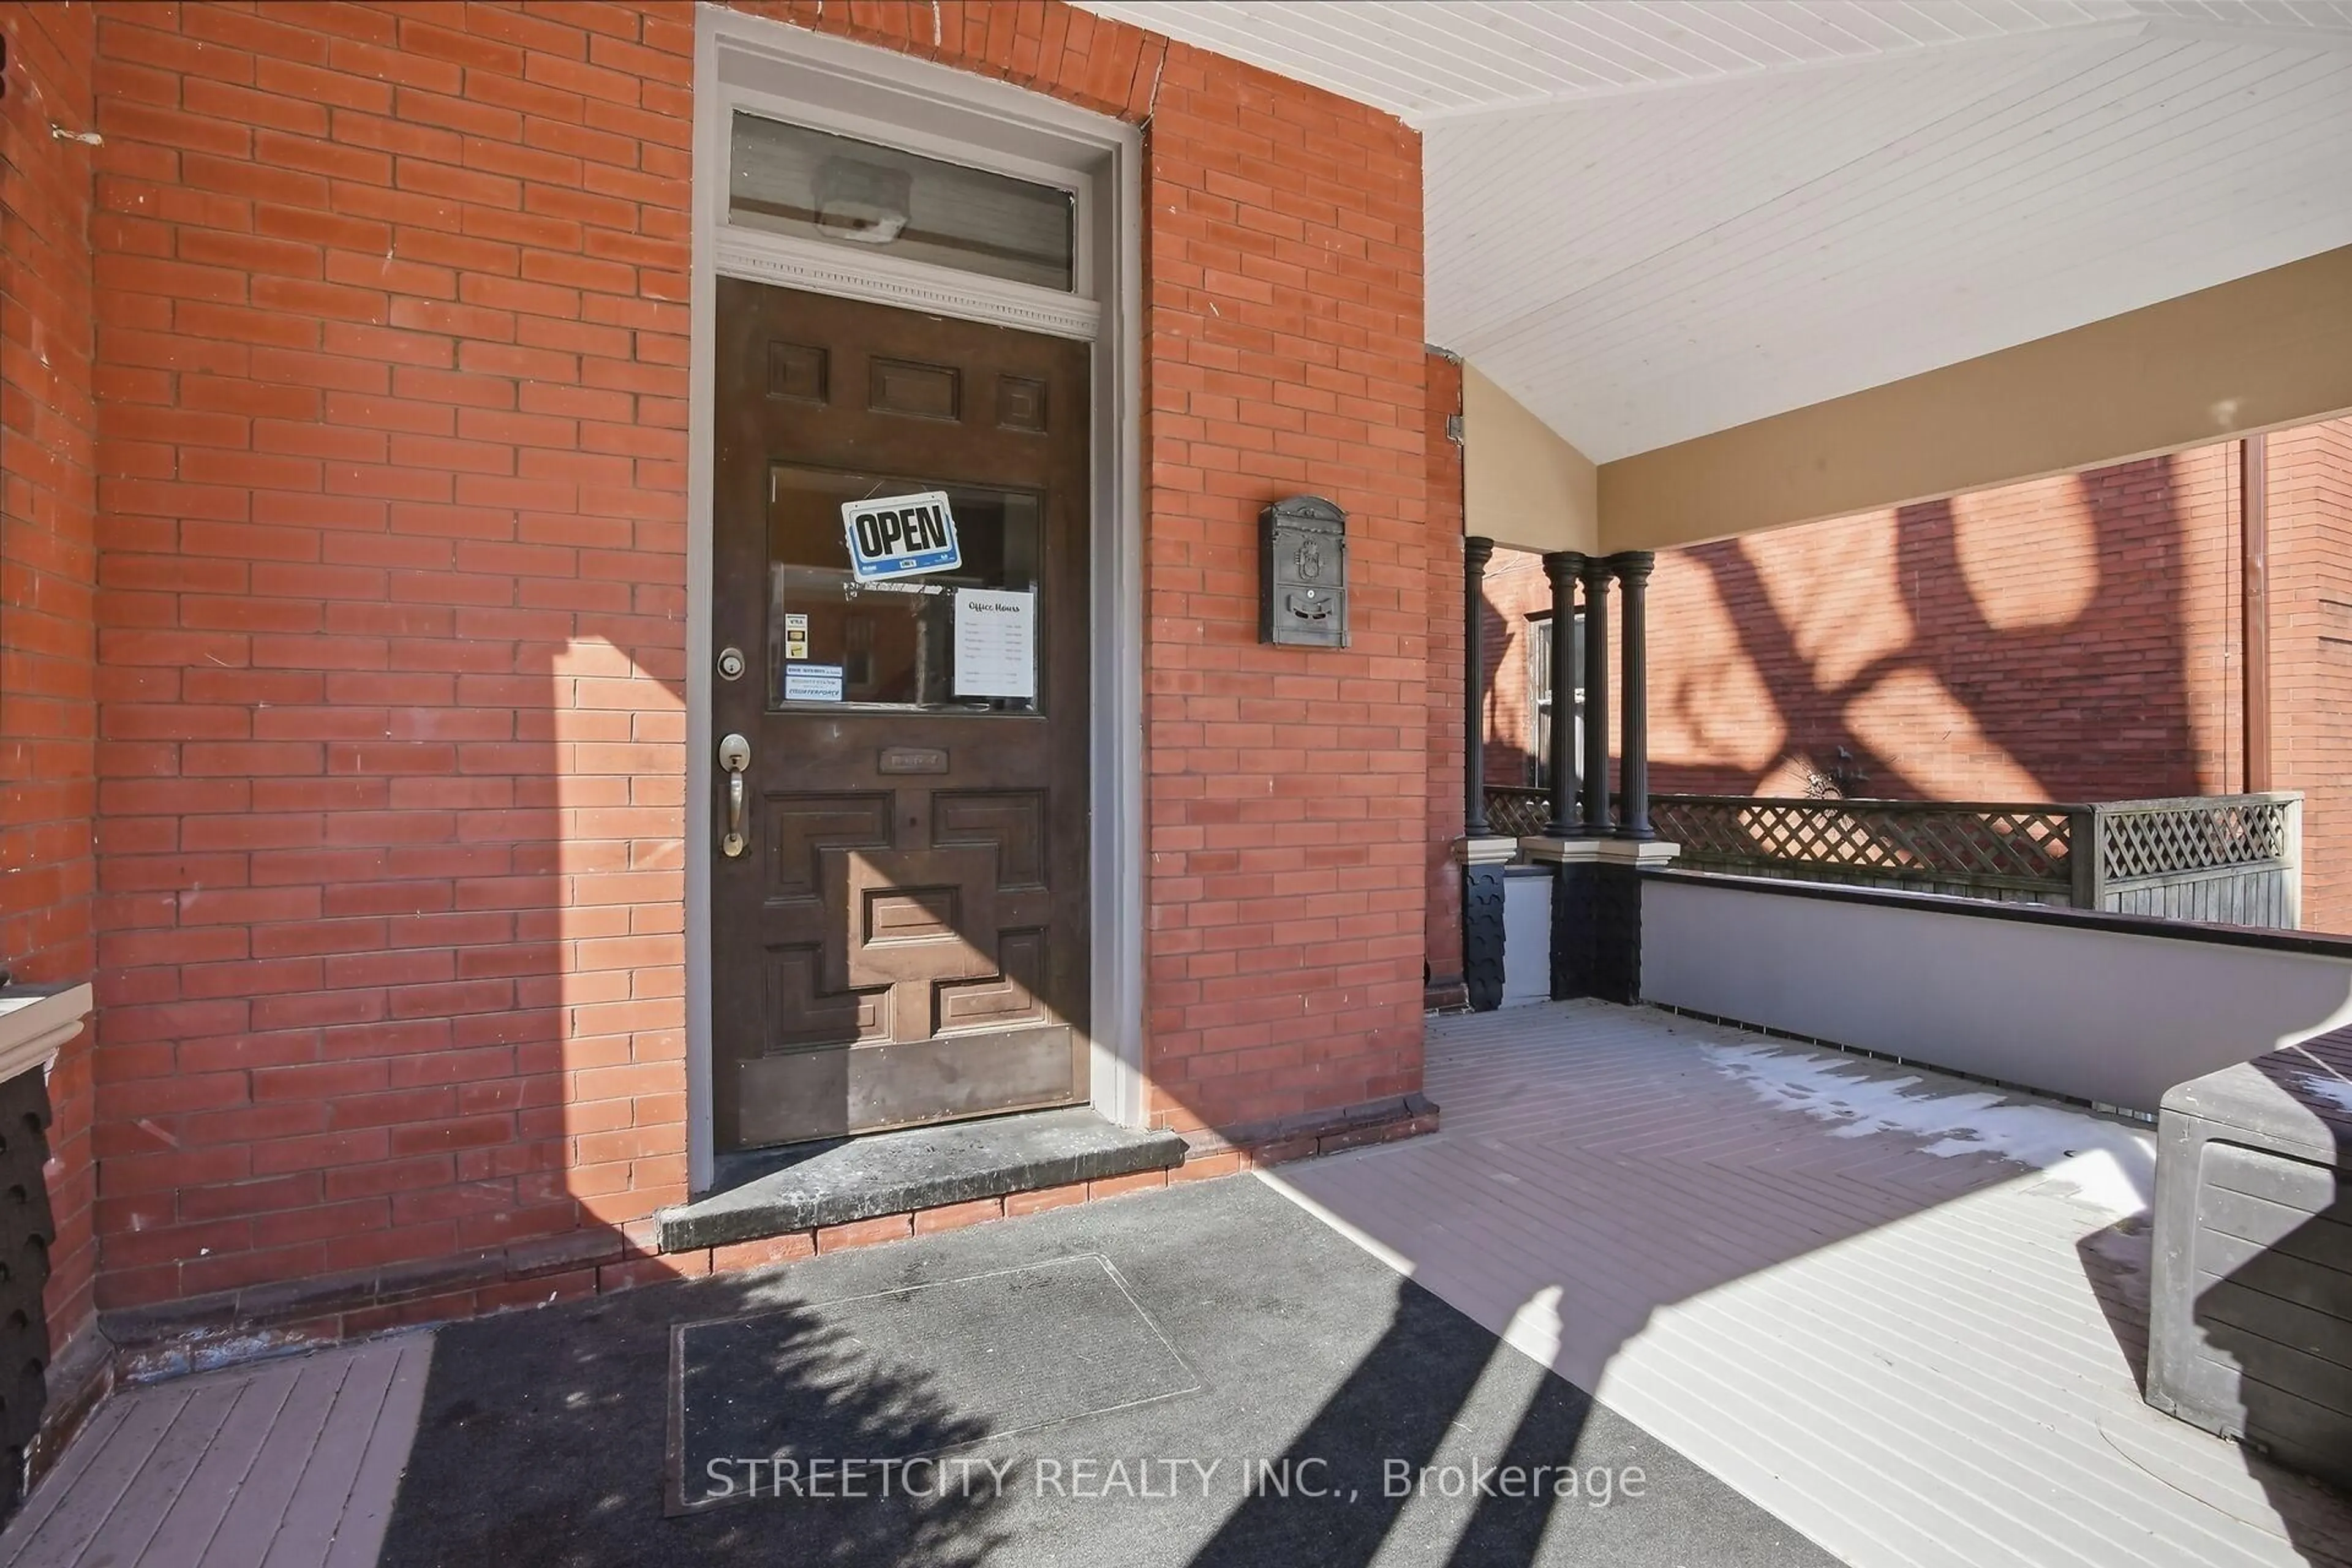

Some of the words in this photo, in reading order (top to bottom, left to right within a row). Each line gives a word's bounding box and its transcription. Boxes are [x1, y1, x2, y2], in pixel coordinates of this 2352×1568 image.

[856, 505, 948, 557] OPEN
[968, 601, 994, 612] Office
[995, 603, 1020, 612] Hours
